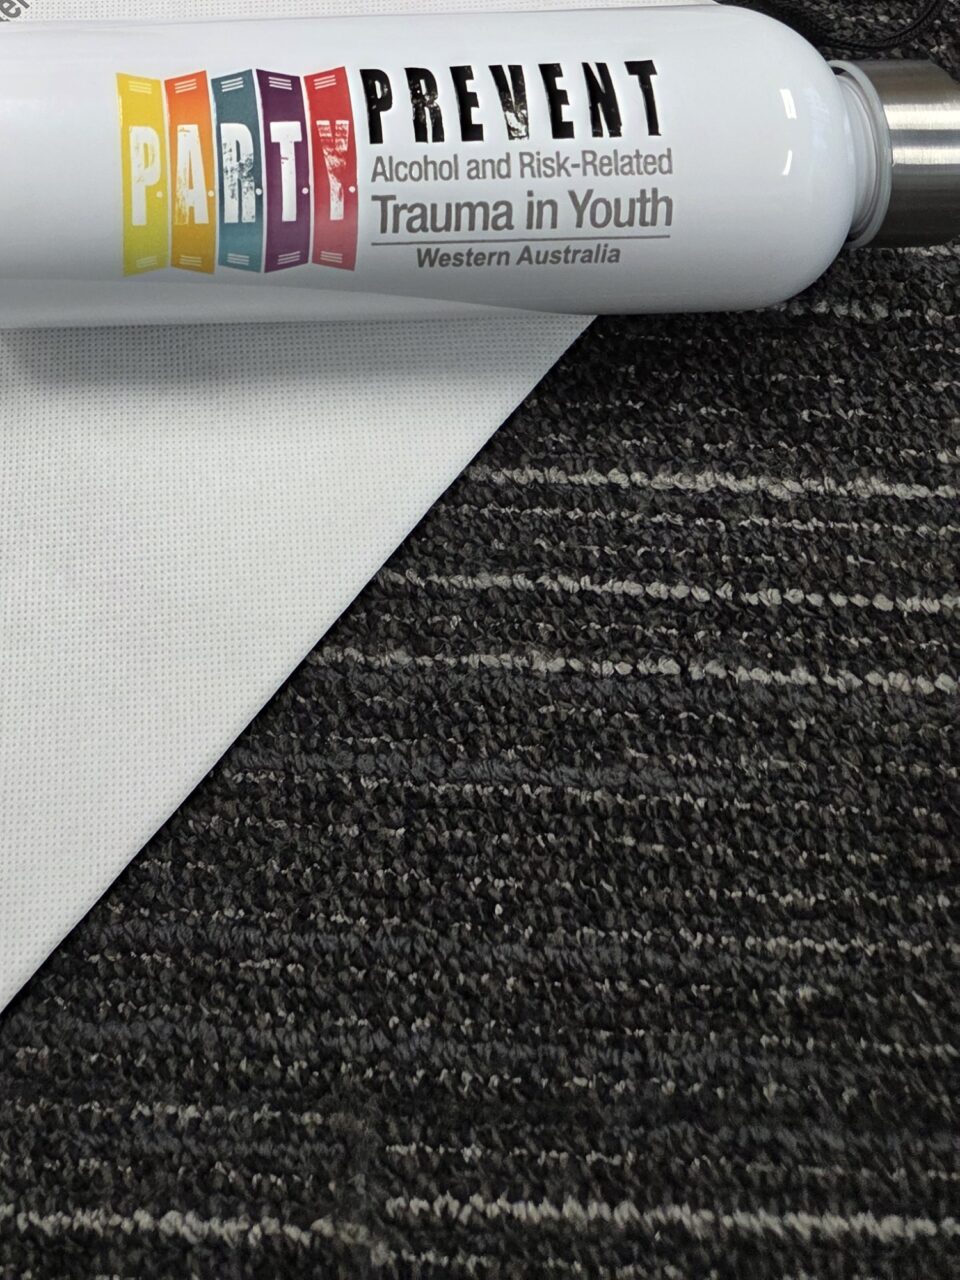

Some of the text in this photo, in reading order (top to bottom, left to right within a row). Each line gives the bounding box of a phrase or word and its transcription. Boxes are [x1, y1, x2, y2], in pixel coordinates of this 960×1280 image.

[359, 59, 662, 145] PREVENT
[370, 147, 673, 183] Alcohol and Risk-Related
[371, 186, 674, 234] Trauma in Youth
[415, 244, 621, 269] Western Australia
